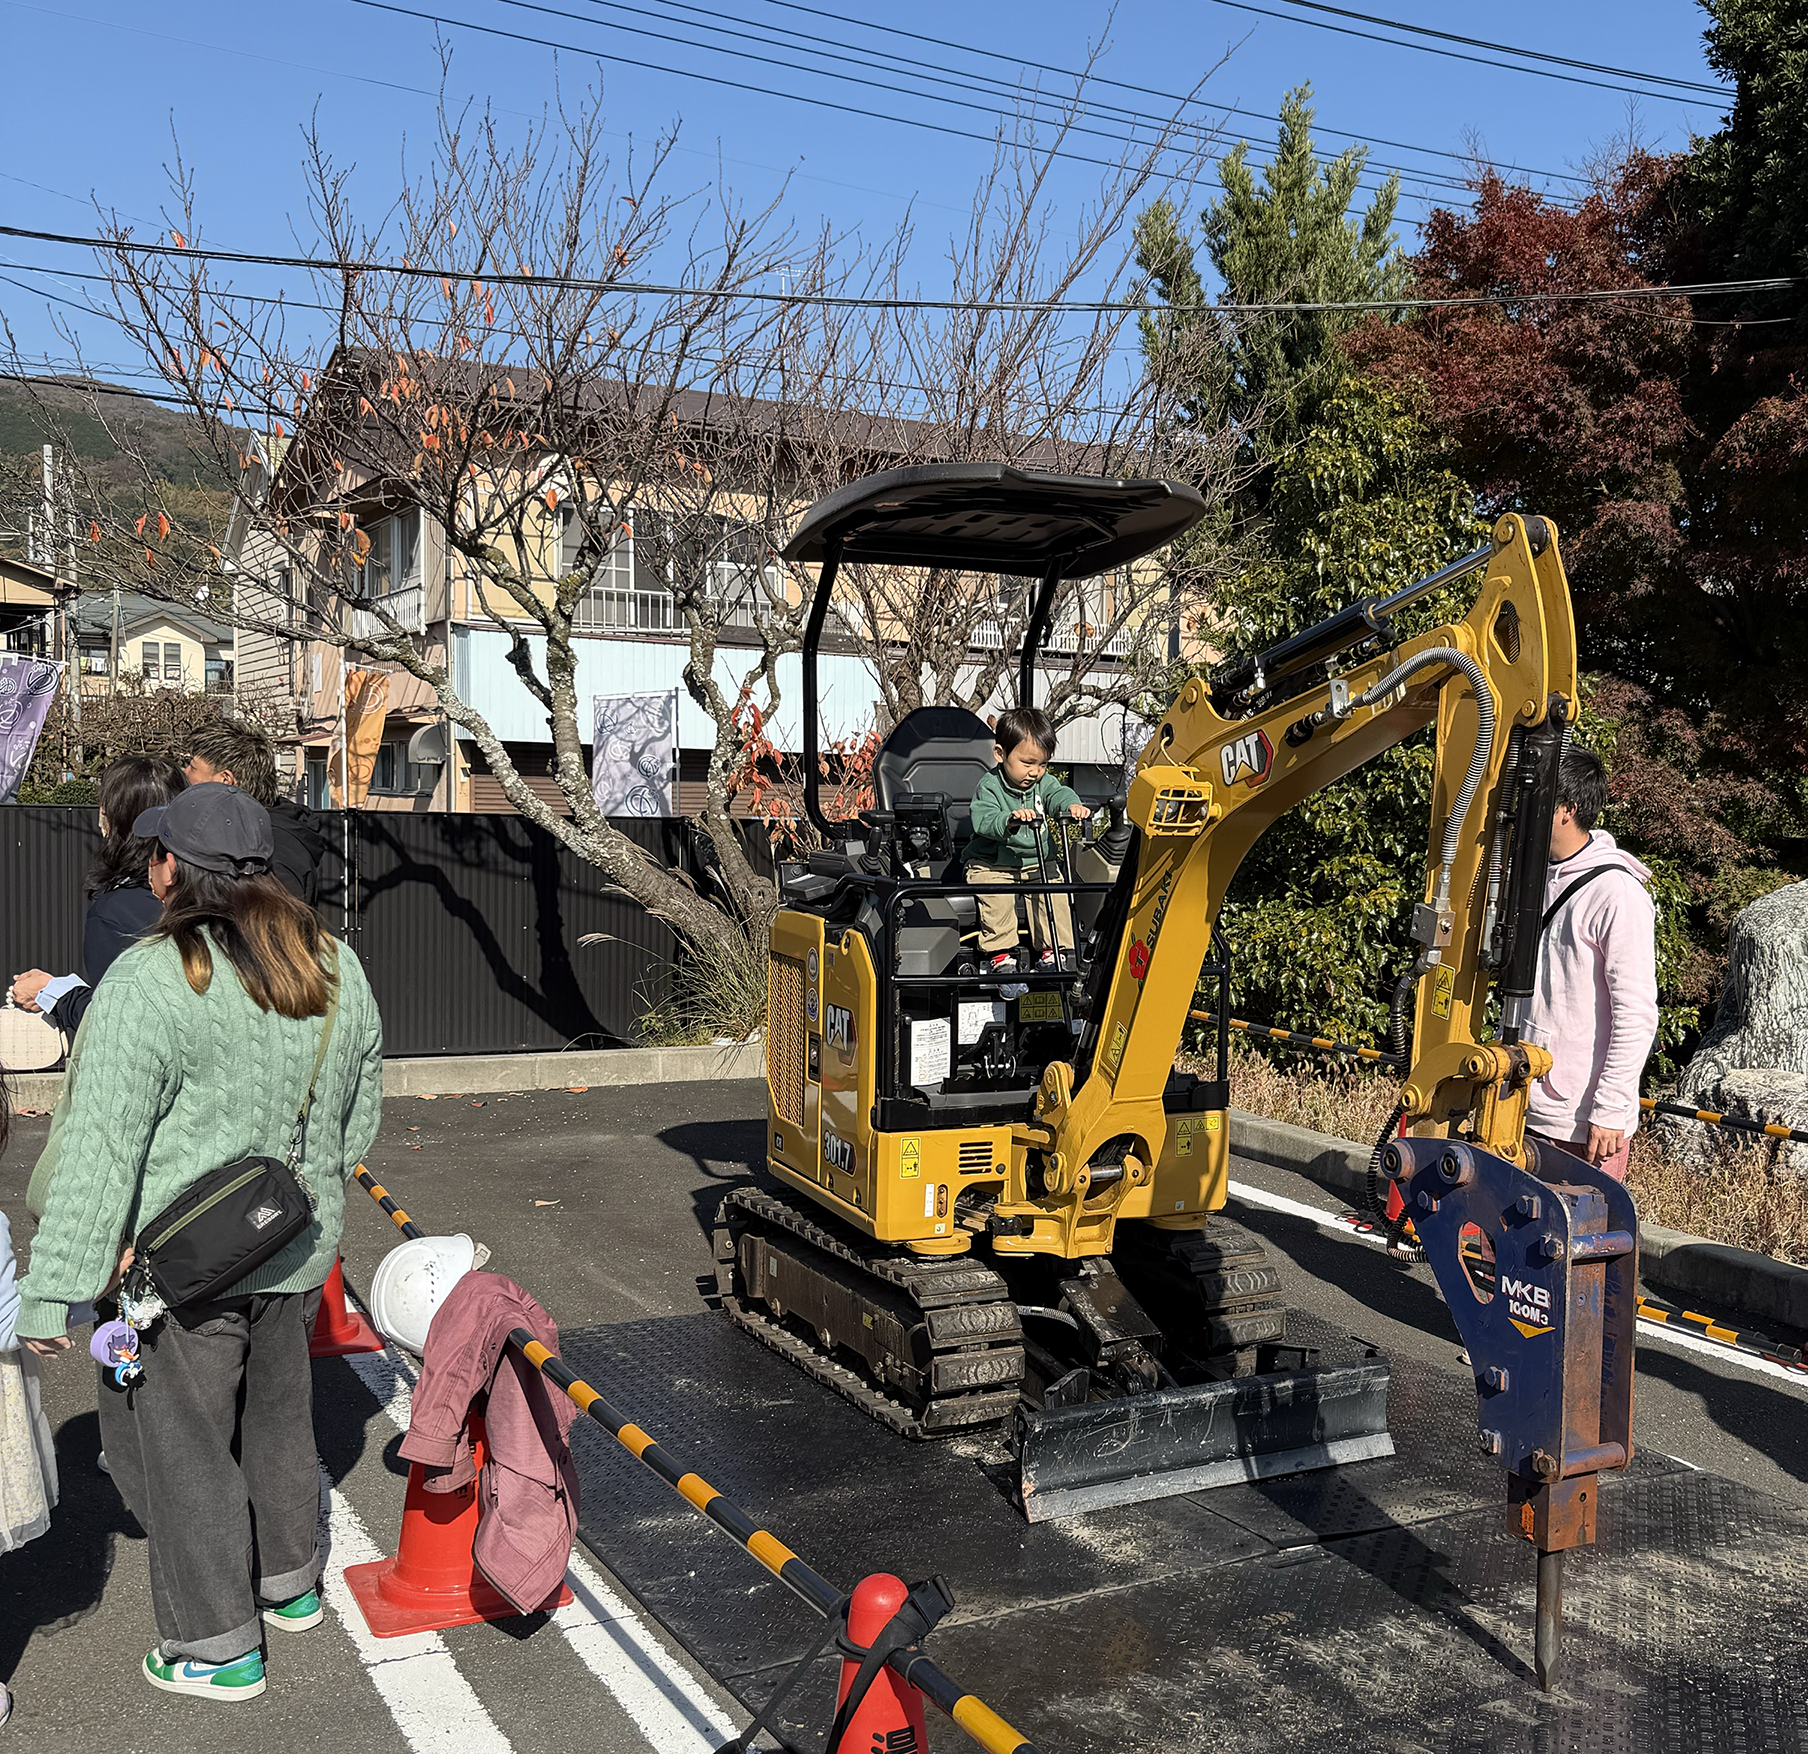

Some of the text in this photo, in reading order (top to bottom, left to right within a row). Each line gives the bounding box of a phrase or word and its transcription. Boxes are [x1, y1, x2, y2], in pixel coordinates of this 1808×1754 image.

[1221, 732, 1259, 785] CAT
[826, 1004, 850, 1052] CAT
[824, 1131, 851, 1171] 301.7
[1501, 1275, 1551, 1309] MKB
